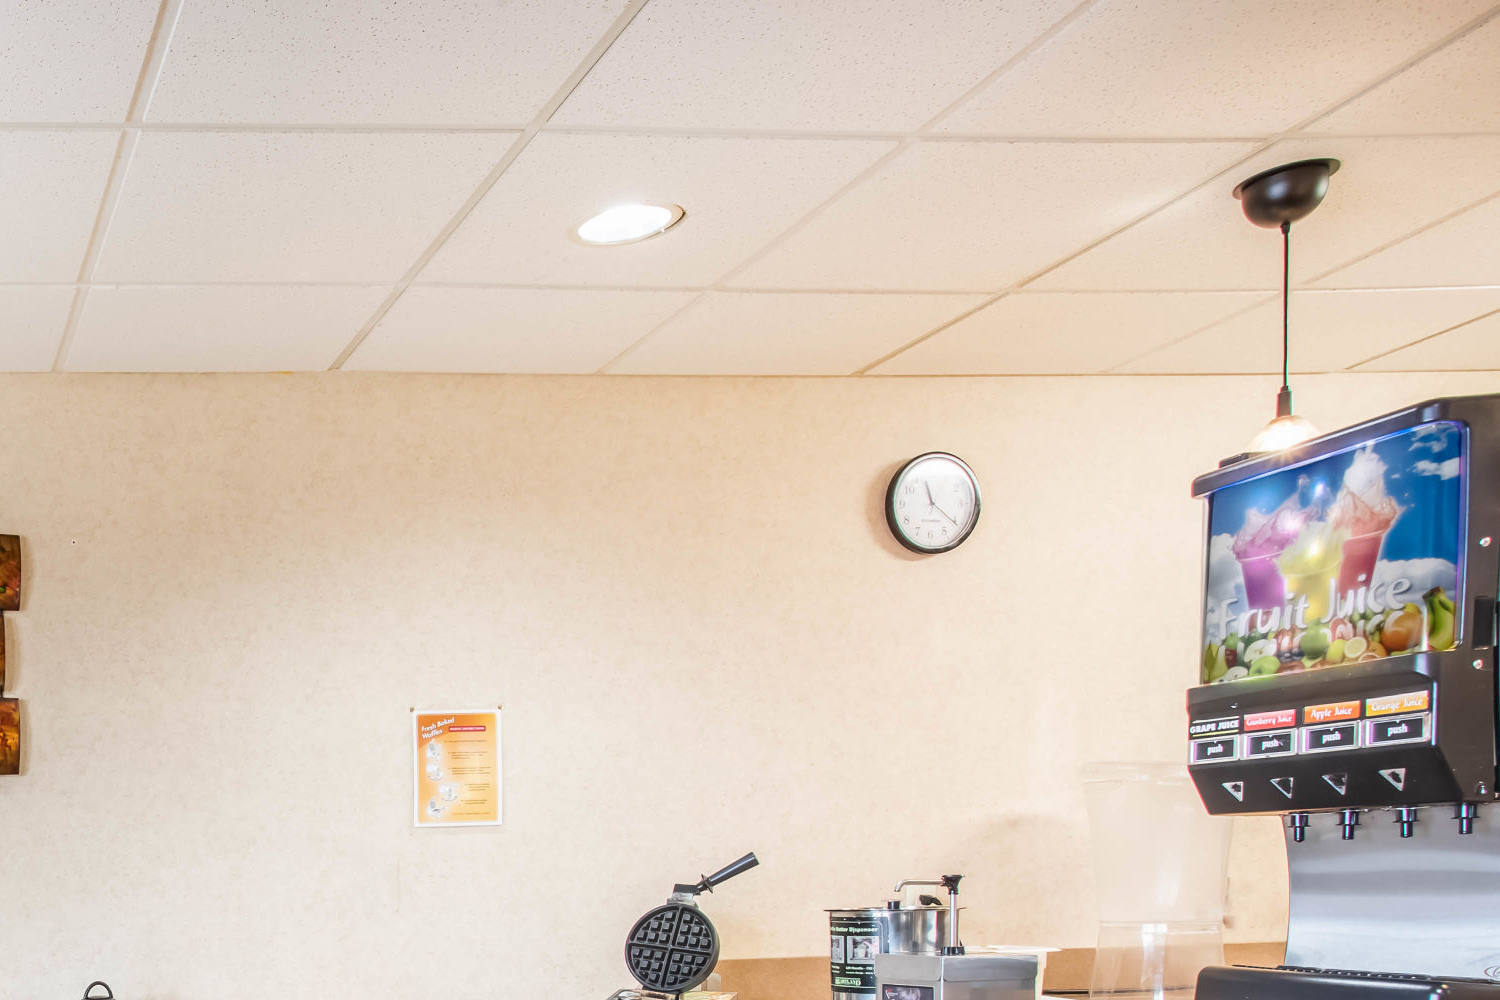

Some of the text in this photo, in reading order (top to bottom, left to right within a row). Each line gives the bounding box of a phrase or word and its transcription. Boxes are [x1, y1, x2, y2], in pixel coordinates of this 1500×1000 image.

[905, 485, 915, 494] 10
[903, 515, 910, 525] 8
[916, 526, 921, 536] 7
[927, 530, 934, 540] 6
[941, 526, 948, 536] 5
[1220, 573, 1412, 640] Fruit Juice
[1371, 697, 1423, 713] Orange Juice
[1310, 706, 1353, 720] Apple Juice
[1190, 720, 1240, 734] GRAPE JUICE
[1246, 715, 1293, 727] Cranberry Juice
[1387, 723, 1408, 737] push
[1322, 731, 1341, 745] push
[1207, 743, 1224, 756] push
[1261, 739, 1279, 751] push
